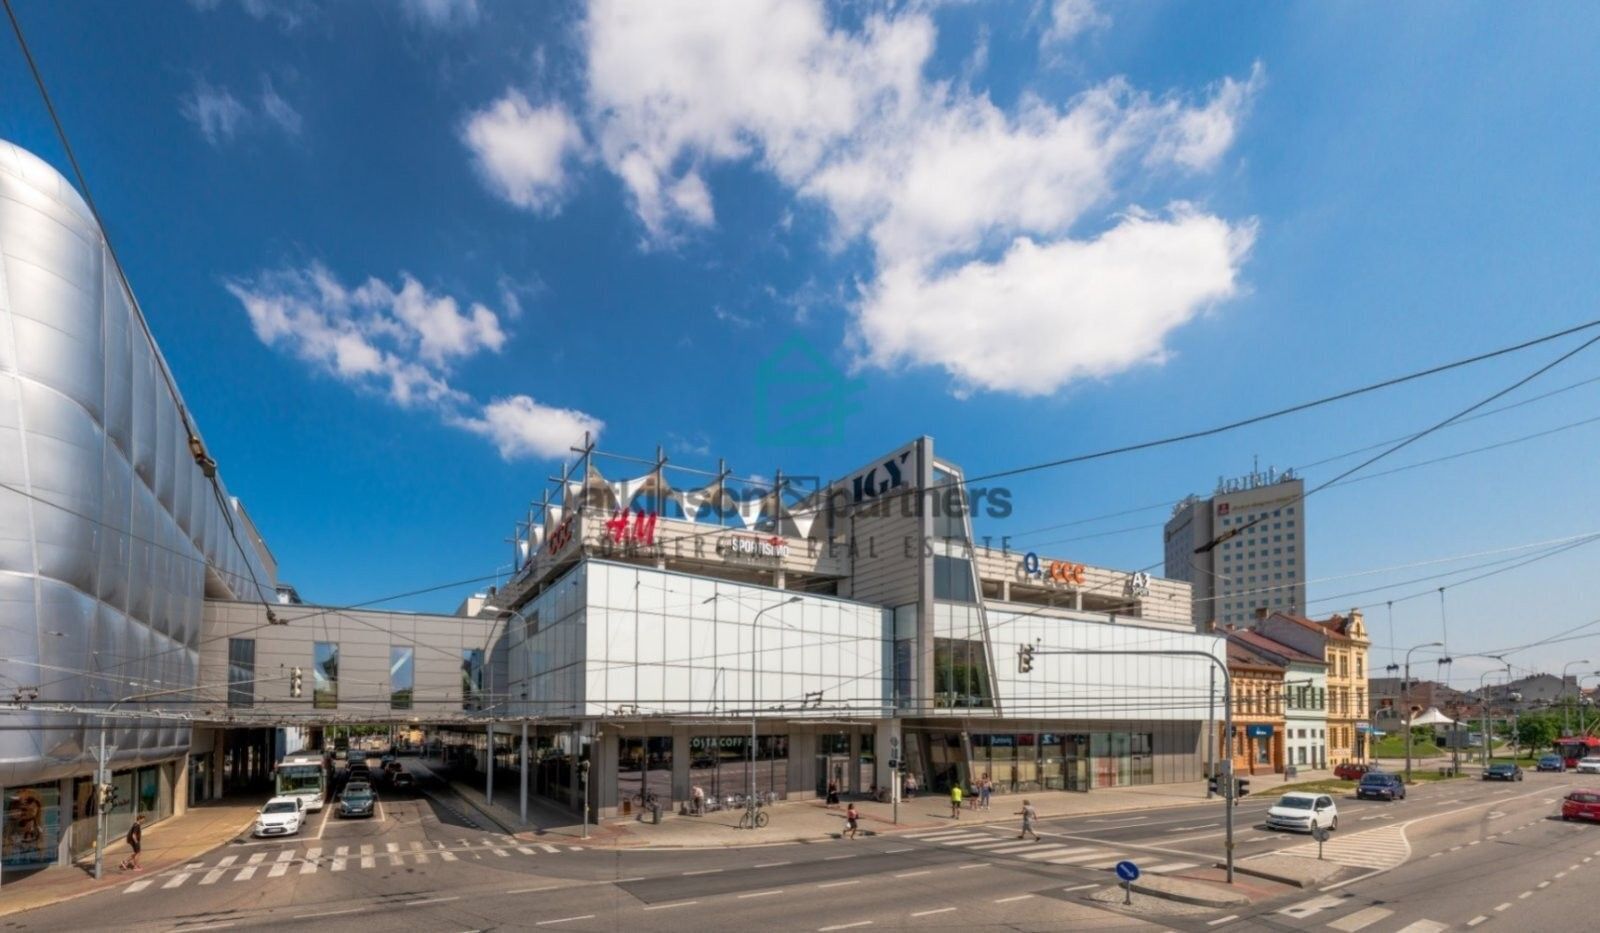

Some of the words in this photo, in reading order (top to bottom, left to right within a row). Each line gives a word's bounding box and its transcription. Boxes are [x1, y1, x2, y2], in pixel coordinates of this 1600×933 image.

[606, 507, 657, 545] HM
[1050, 560, 1085, 584] CCC
[719, 737, 754, 748] COFFE
